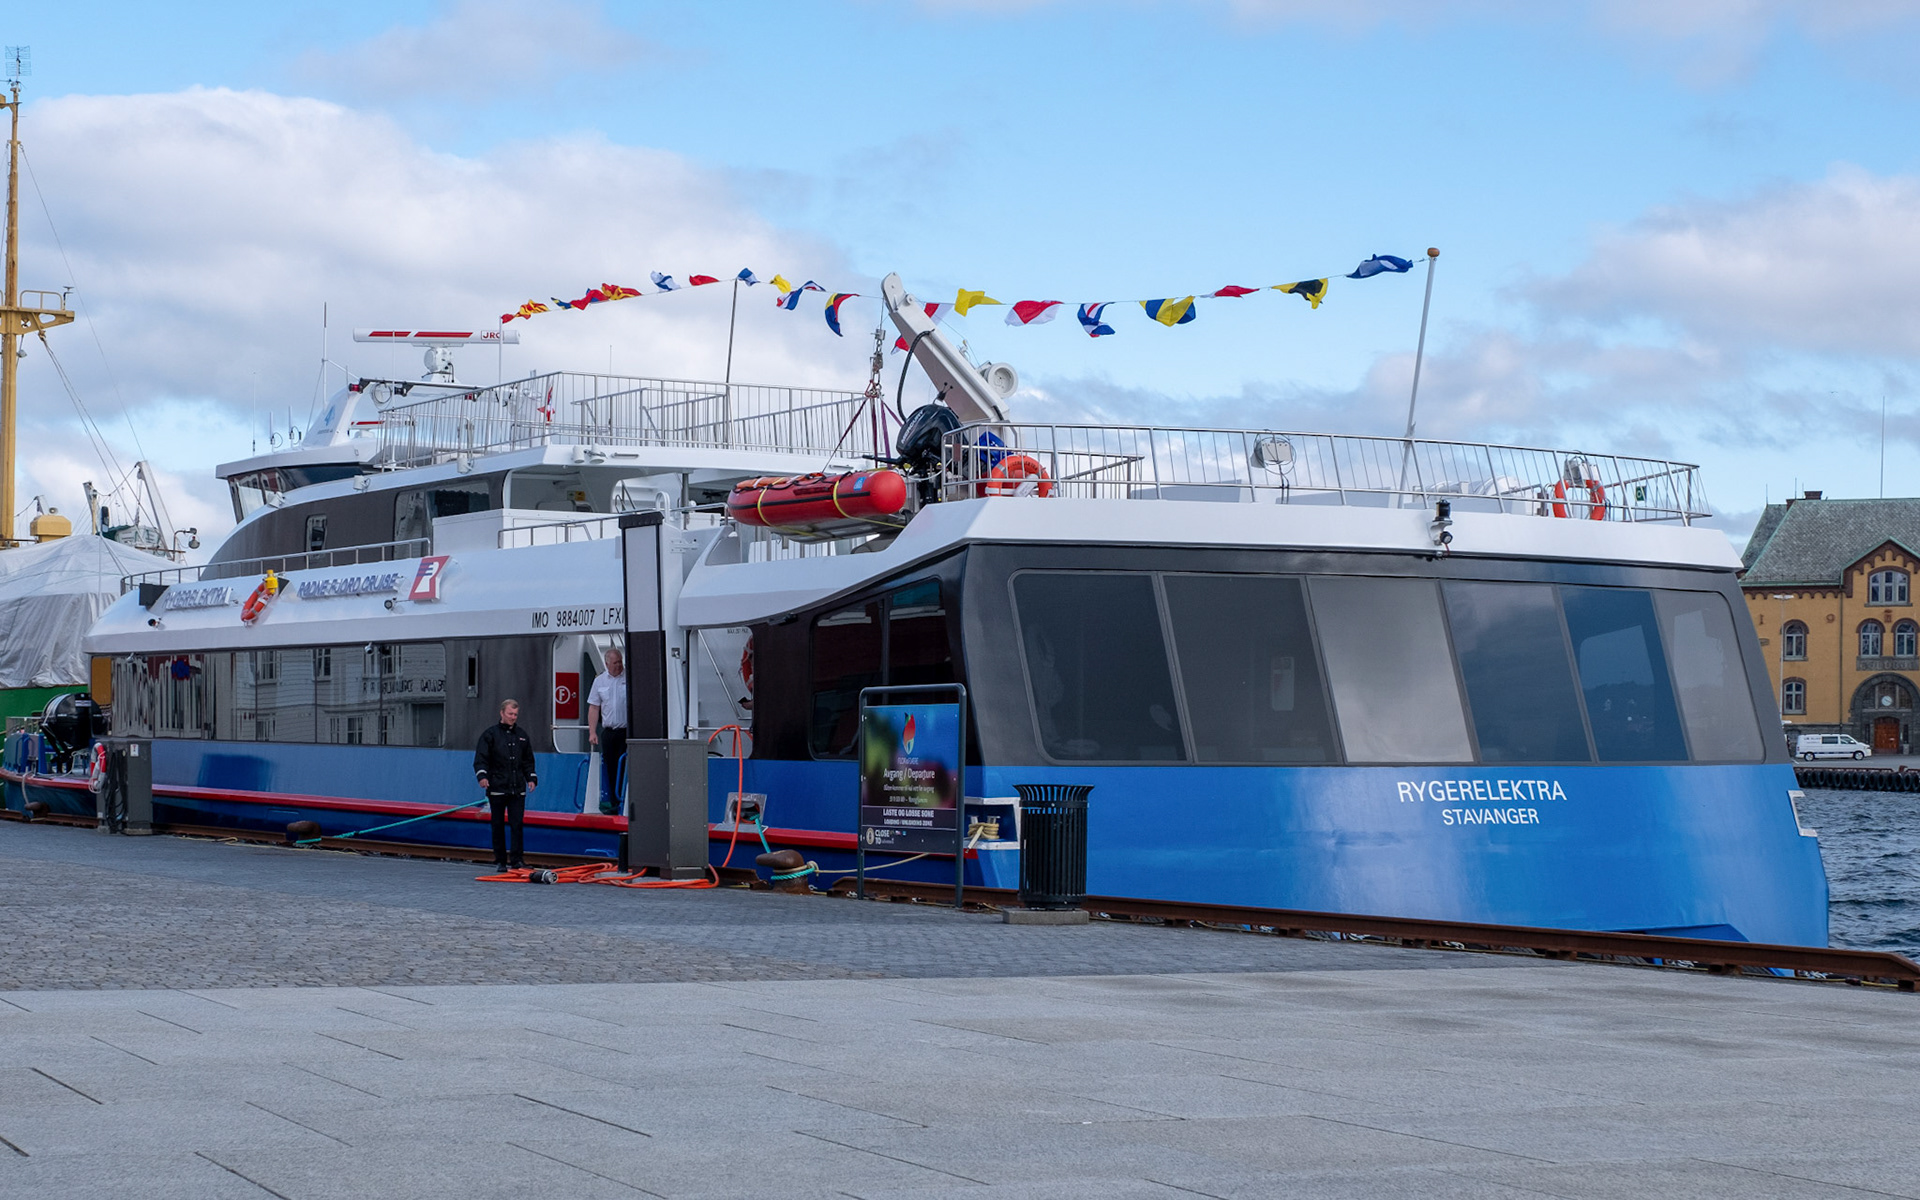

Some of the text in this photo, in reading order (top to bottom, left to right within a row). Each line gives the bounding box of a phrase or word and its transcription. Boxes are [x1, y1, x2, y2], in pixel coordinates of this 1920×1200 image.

[328, 577, 361, 595] FJORD
[361, 573, 399, 592] CRUISE
[532, 611, 549, 628] IMO
[556, 609, 595, 627] 9884007
[883, 768, 903, 781] Avgang
[908, 768, 935, 781] Departure
[1397, 780, 1568, 803] RYGERELEKTRA
[883, 808, 897, 816] LASTE
[898, 809, 905, 817] OG
[921, 810, 935, 818] SONE
[1442, 808, 1540, 825] STAVANGER
